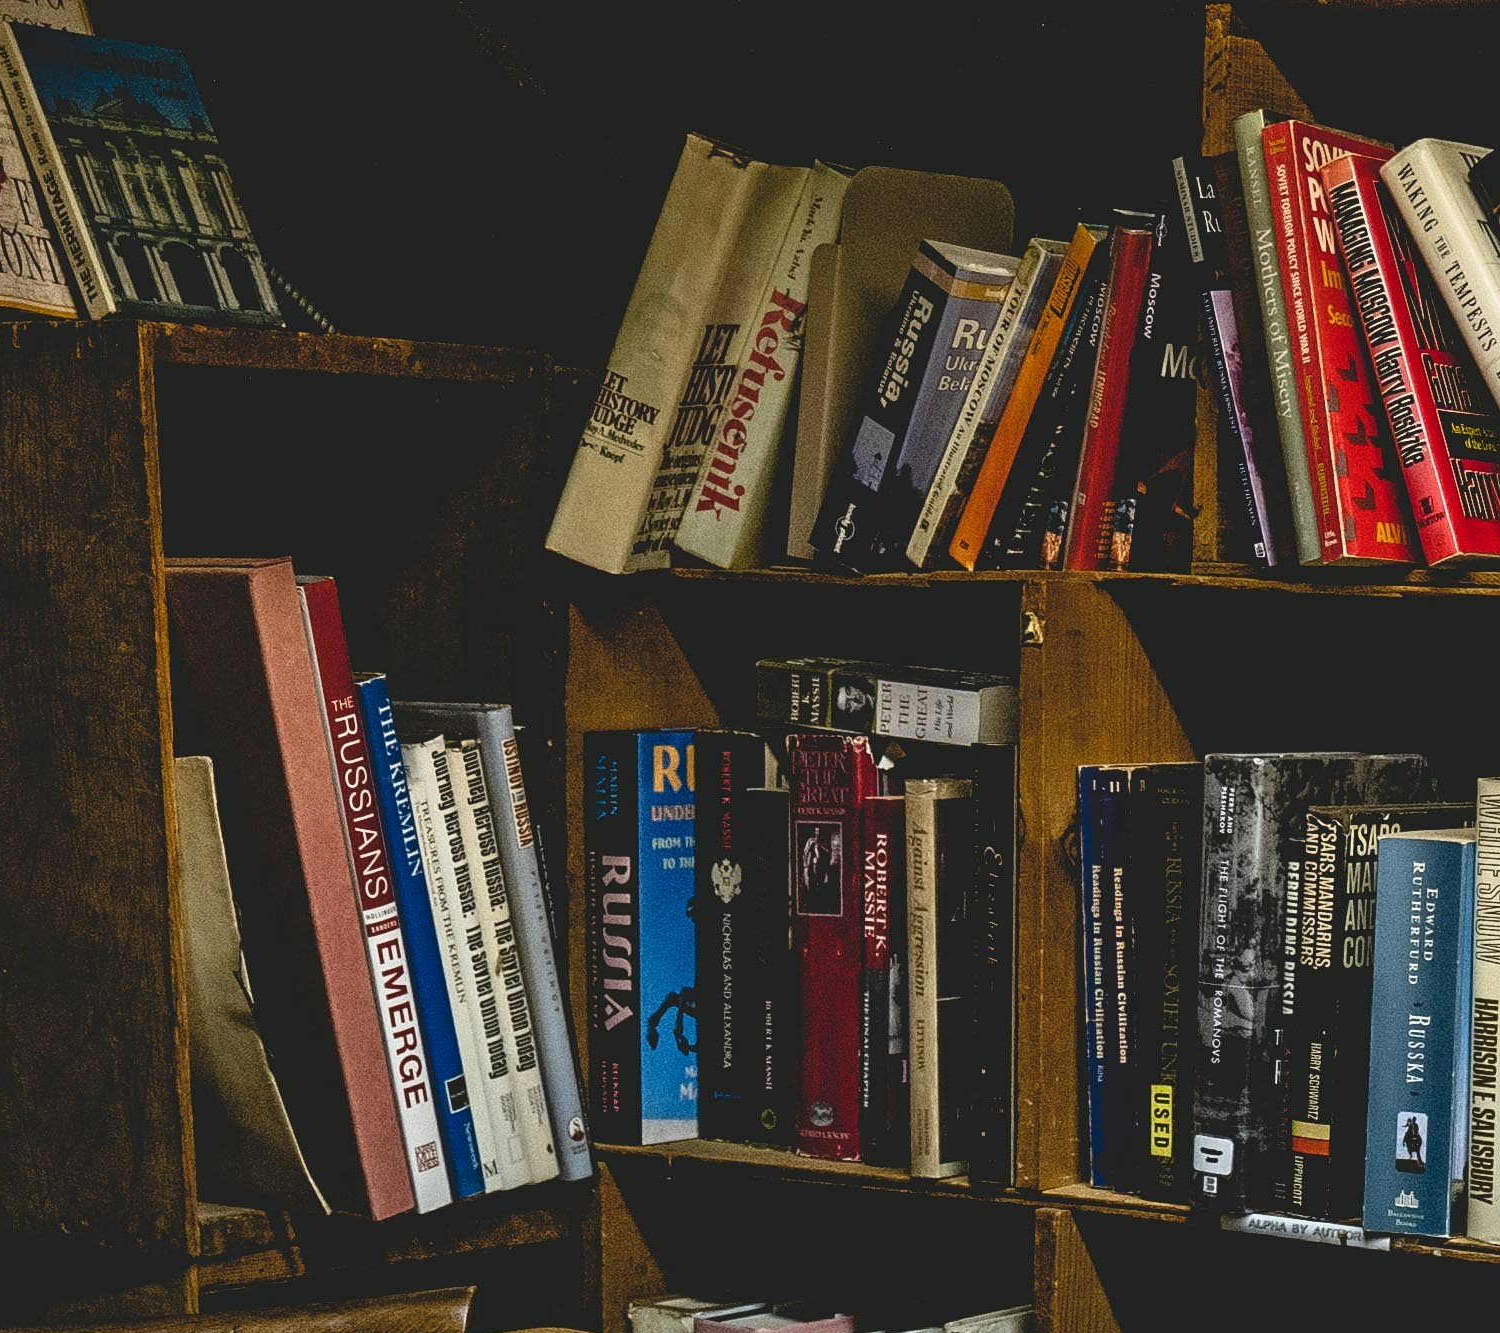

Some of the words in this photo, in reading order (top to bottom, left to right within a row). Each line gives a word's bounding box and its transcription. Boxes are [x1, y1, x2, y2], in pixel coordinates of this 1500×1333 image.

[1398, 163, 1437, 233] WAKING
[1446, 265, 1498, 353] TEMPESTS
[696, 291, 809, 521] Refusenik
[331, 696, 354, 712] THE
[335, 715, 388, 899] RUSSIANS
[376, 697, 398, 748] THE
[389, 761, 421, 877] KREMLIN
[722, 913, 732, 970] NICHOLAS
[377, 937, 428, 1108] EMERGE
[724, 975, 734, 1005] AND
[724, 1006, 734, 1070] ALEXANDRA
[1472, 998, 1499, 1088] HARRISON
[1154, 1093, 1170, 1148] USED
[1467, 1107, 1496, 1206] SALISBURY
